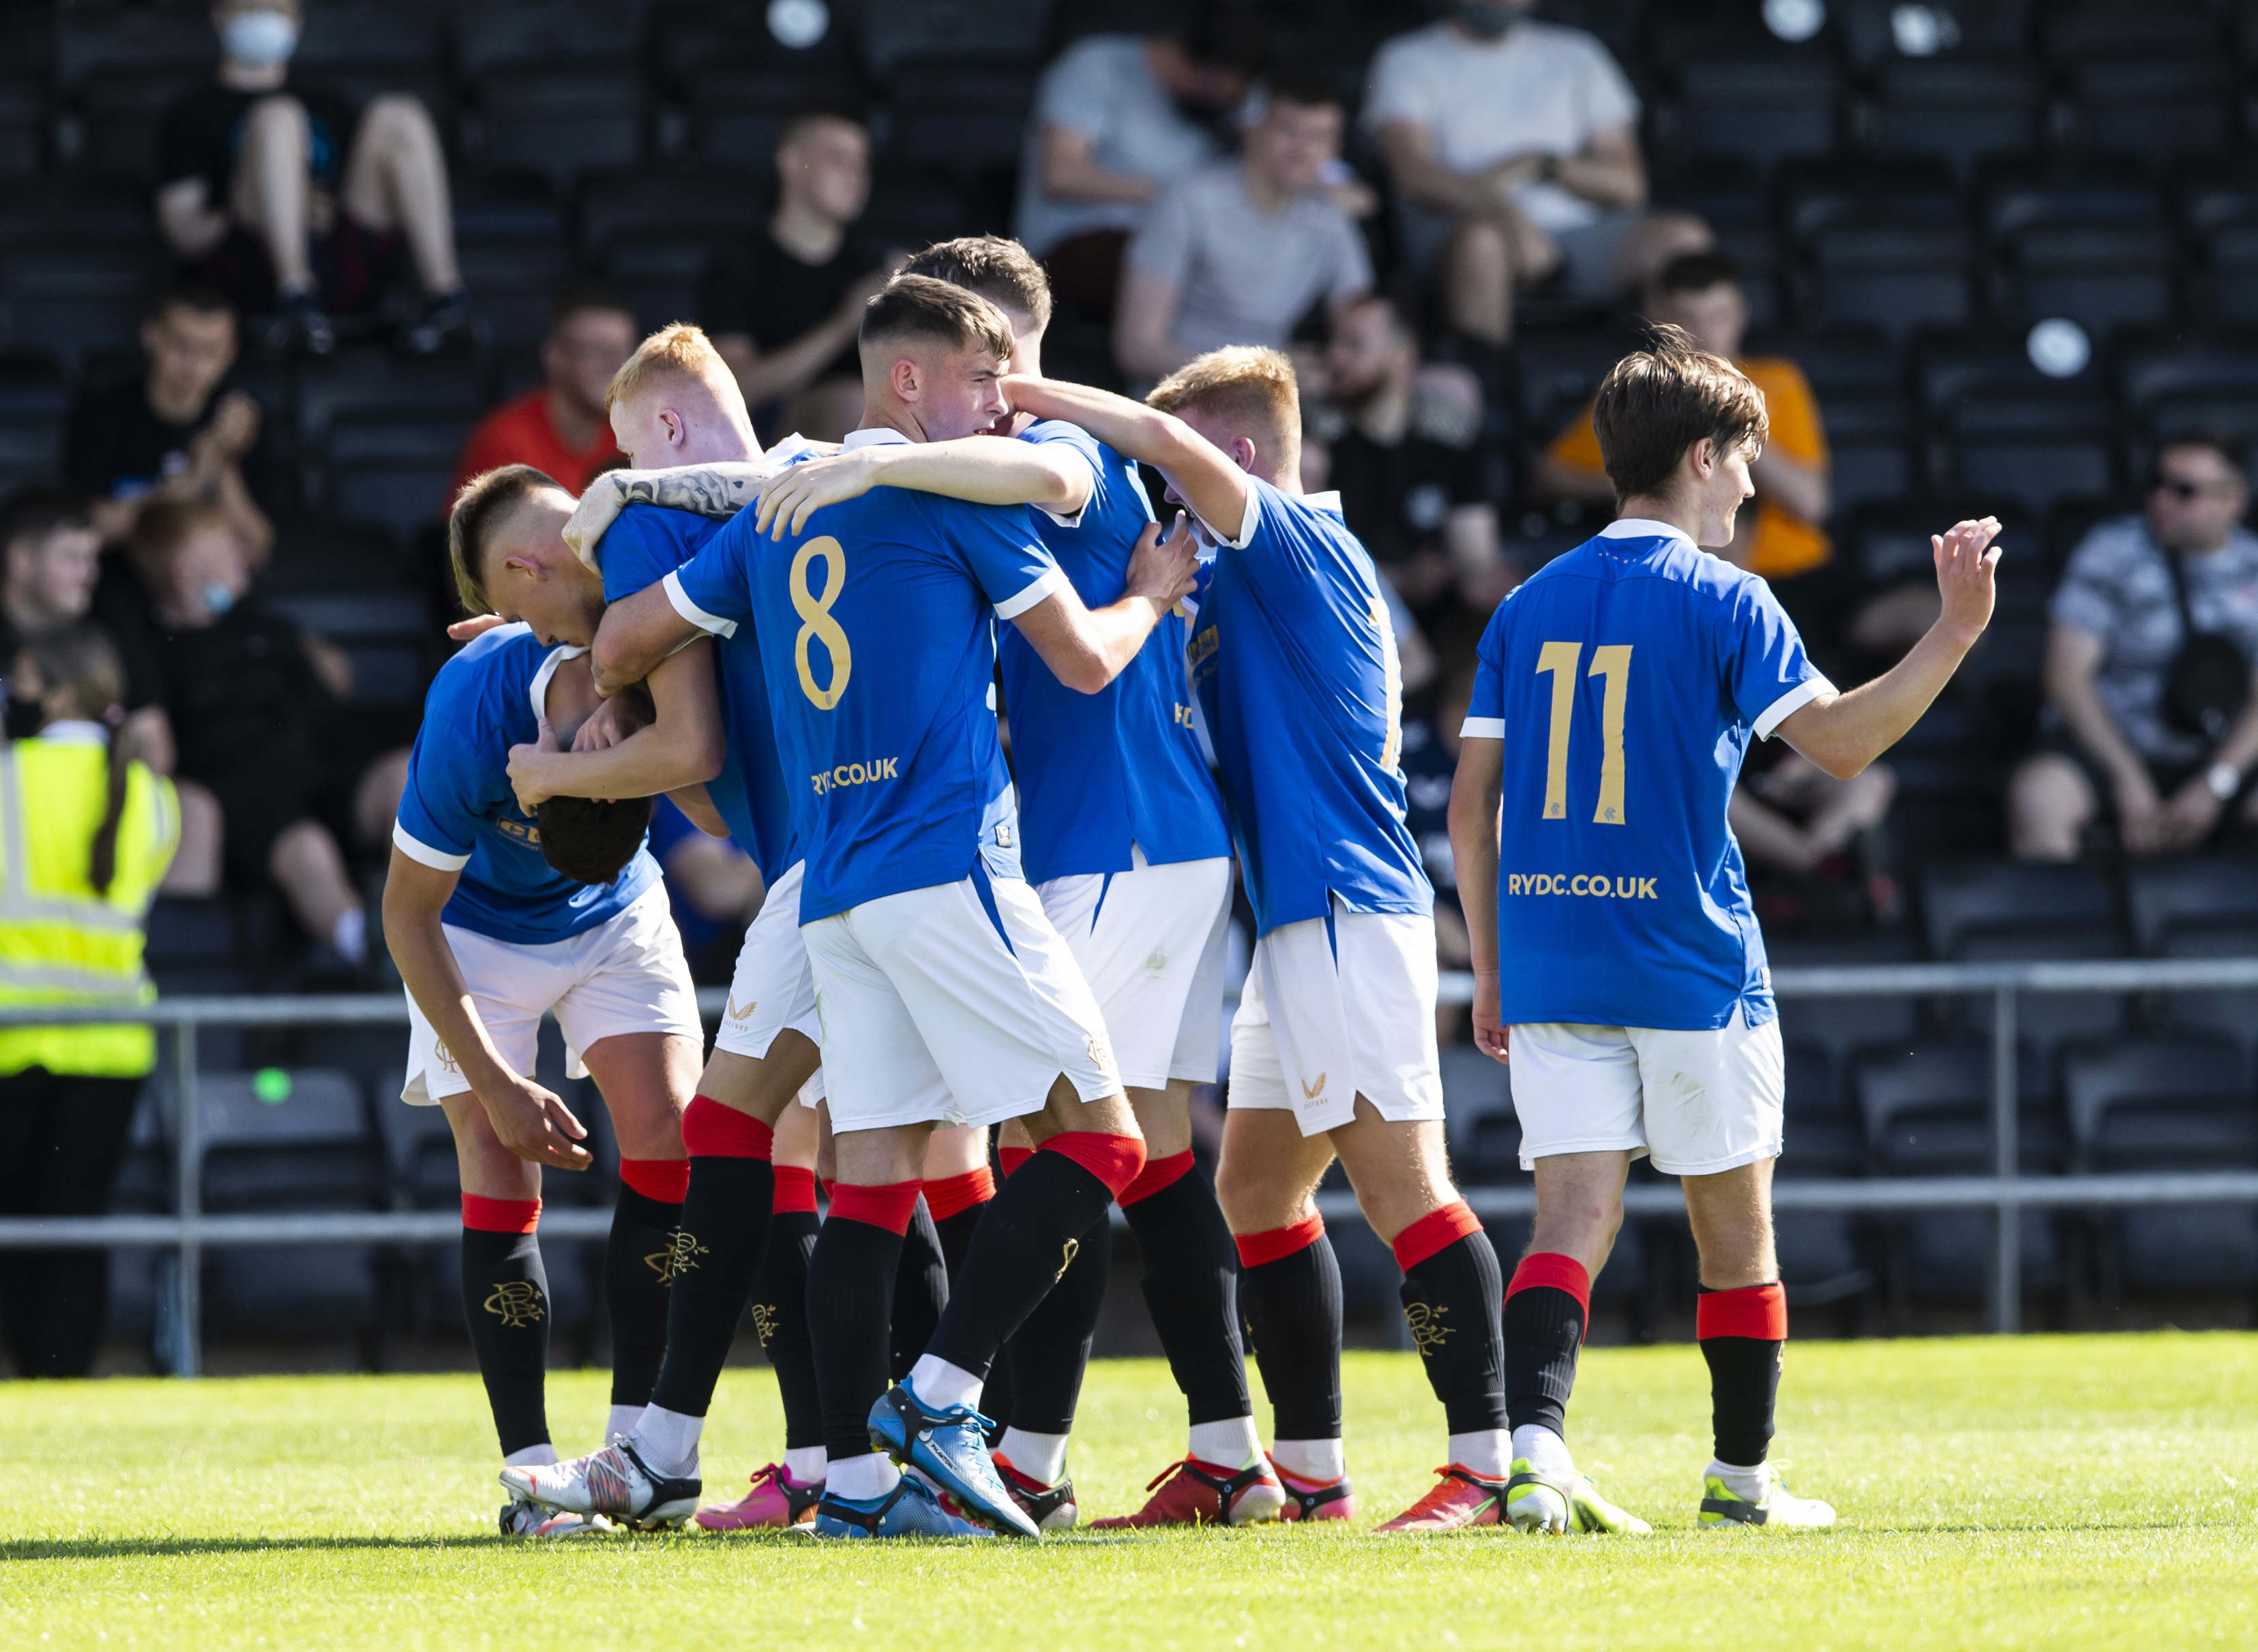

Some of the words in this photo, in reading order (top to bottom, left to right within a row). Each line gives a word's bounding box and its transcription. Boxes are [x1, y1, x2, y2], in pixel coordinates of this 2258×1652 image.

[790, 535, 852, 710] 8
[1535, 641, 1634, 826] 11
[1508, 873, 1659, 899] RYDC.CO.UK
